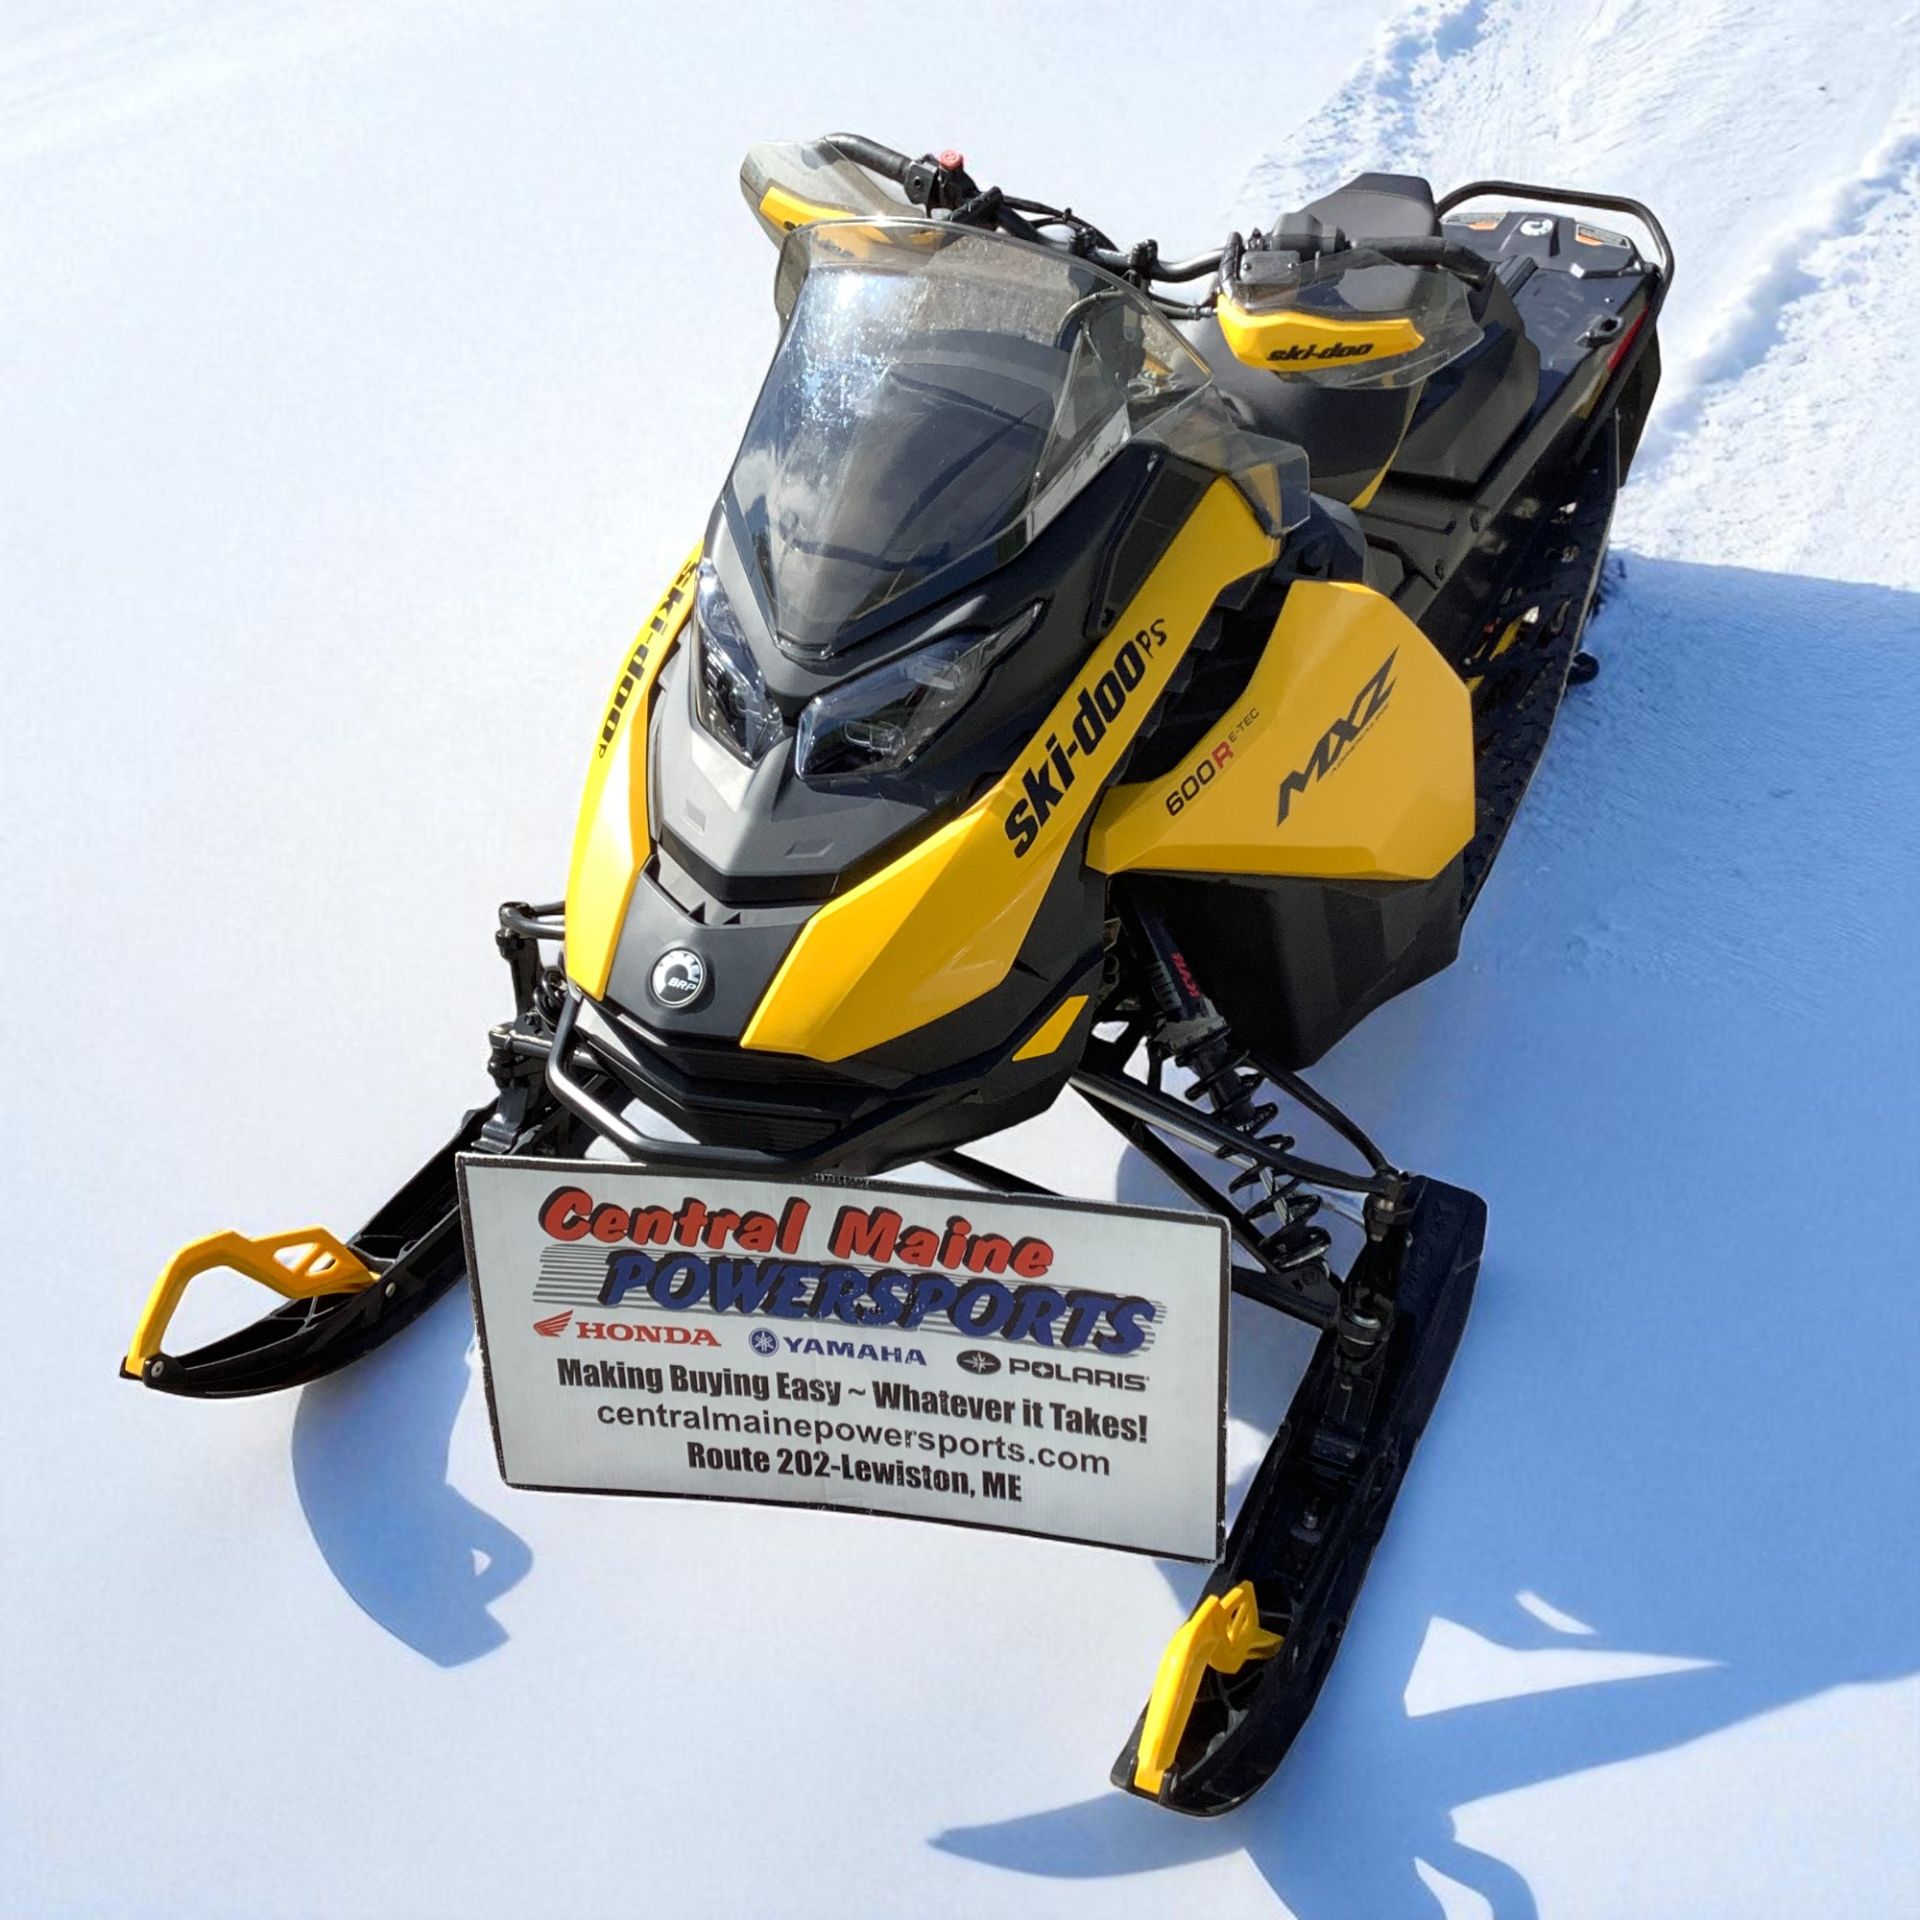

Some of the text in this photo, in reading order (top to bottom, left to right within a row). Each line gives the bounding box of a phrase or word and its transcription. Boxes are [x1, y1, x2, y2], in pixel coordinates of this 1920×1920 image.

[667, 977, 697, 991] BRP
[538, 1186, 1054, 1278] Central Maine
[597, 1249, 1156, 1355] POWERSPORTS
[576, 1322, 721, 1347] HONDA
[783, 1336, 927, 1366] YAMAHA
[557, 1358, 663, 1394] Making
[669, 1364, 769, 1401] Buying
[776, 1372, 841, 1406] Easy
[872, 1381, 1015, 1424] Whatever
[1022, 1399, 1043, 1428] it
[1049, 1402, 1148, 1443] Takes!
[1009, 1357, 1148, 1391] POLARIS
[597, 1403, 1110, 1476] centralmainepowersports.com
[687, 1441, 1022, 1502] Route 202-Lewiston, ME
